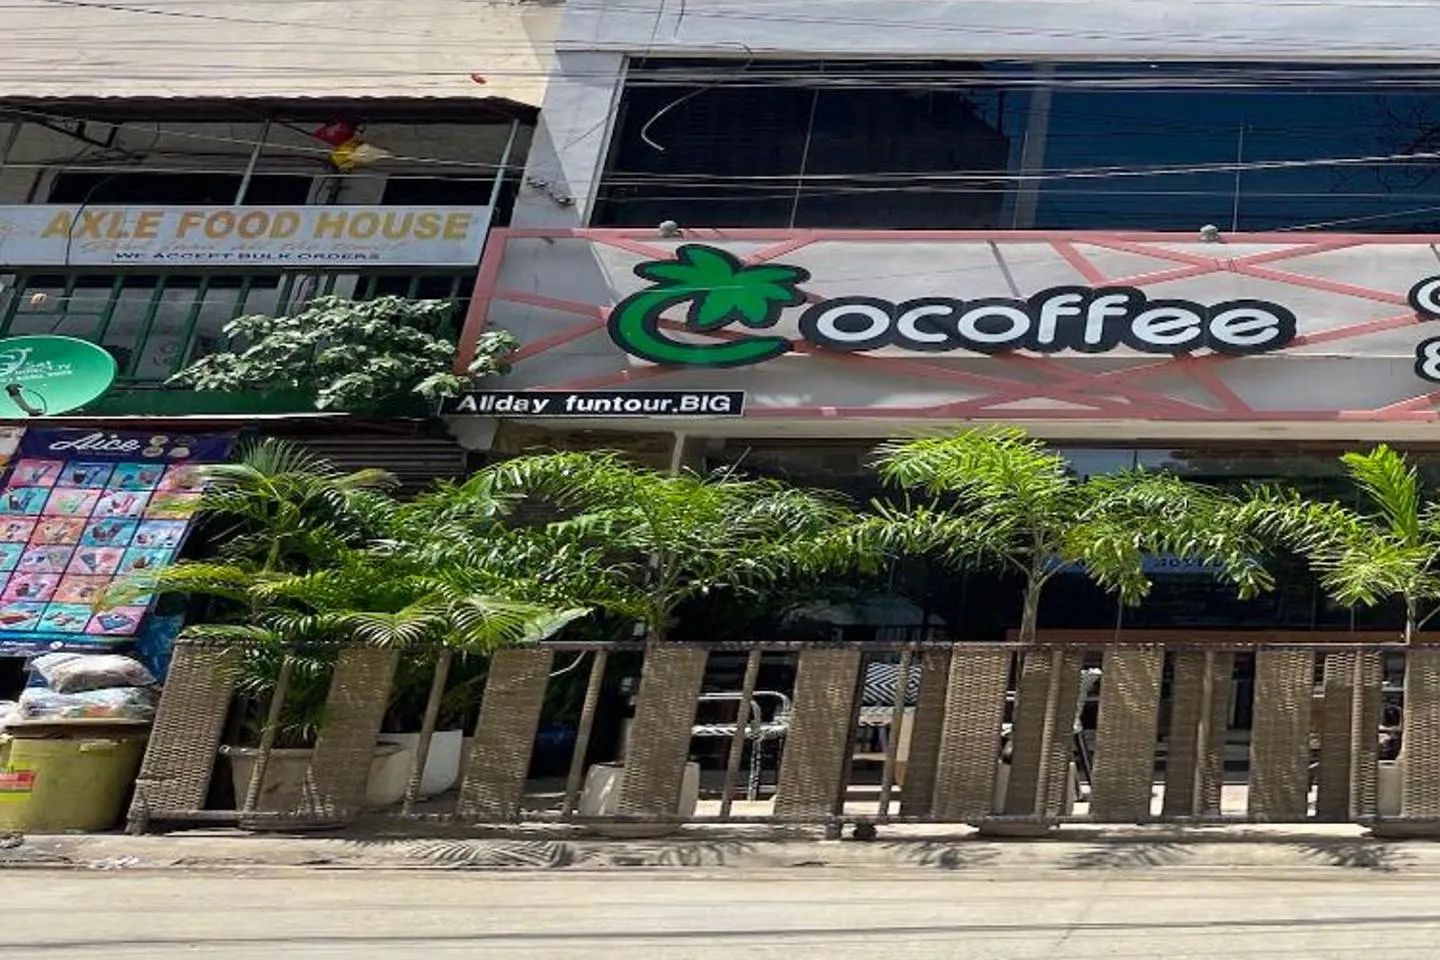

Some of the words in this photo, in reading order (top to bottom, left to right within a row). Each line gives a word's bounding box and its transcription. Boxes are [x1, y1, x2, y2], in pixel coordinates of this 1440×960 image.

[40, 210, 164, 239] AXLE
[176, 210, 300, 240] FOOD
[313, 210, 472, 240] HOUSE
[115, 252, 142, 260] WE
[152, 252, 234, 260] ACCEPT
[237, 251, 290, 260] BULK
[297, 251, 380, 260] ORDERS
[457, 395, 549, 413] Allday
[566, 395, 732, 413] funtour.BIG
